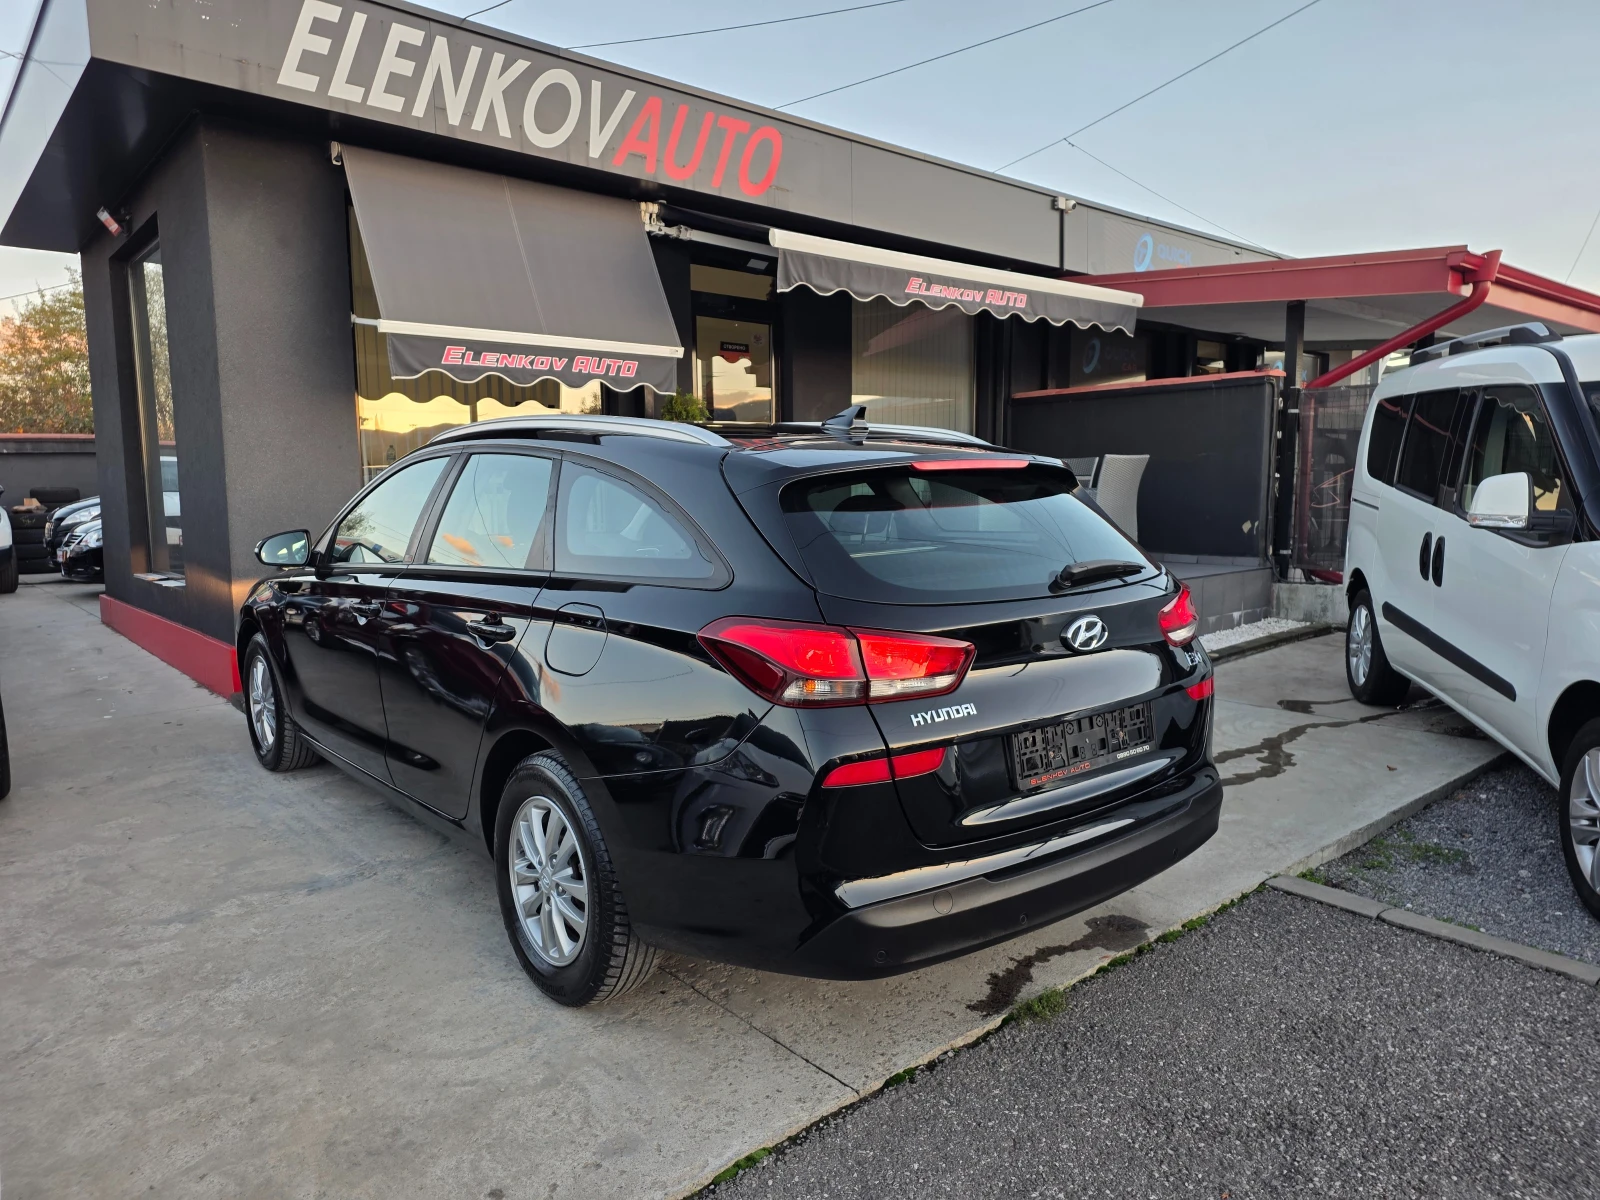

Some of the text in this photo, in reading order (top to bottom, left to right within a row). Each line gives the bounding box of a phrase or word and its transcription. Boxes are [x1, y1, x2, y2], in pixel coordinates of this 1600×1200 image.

[277, 0, 783, 196] ELENKOV AUTO
[905, 277, 1027, 308] ELENKOV AUTO
[441, 345, 638, 377] ELENKOV AUTO
[910, 703, 977, 727] HYUNDAI
[1070, 762, 1090, 773] AUTO
